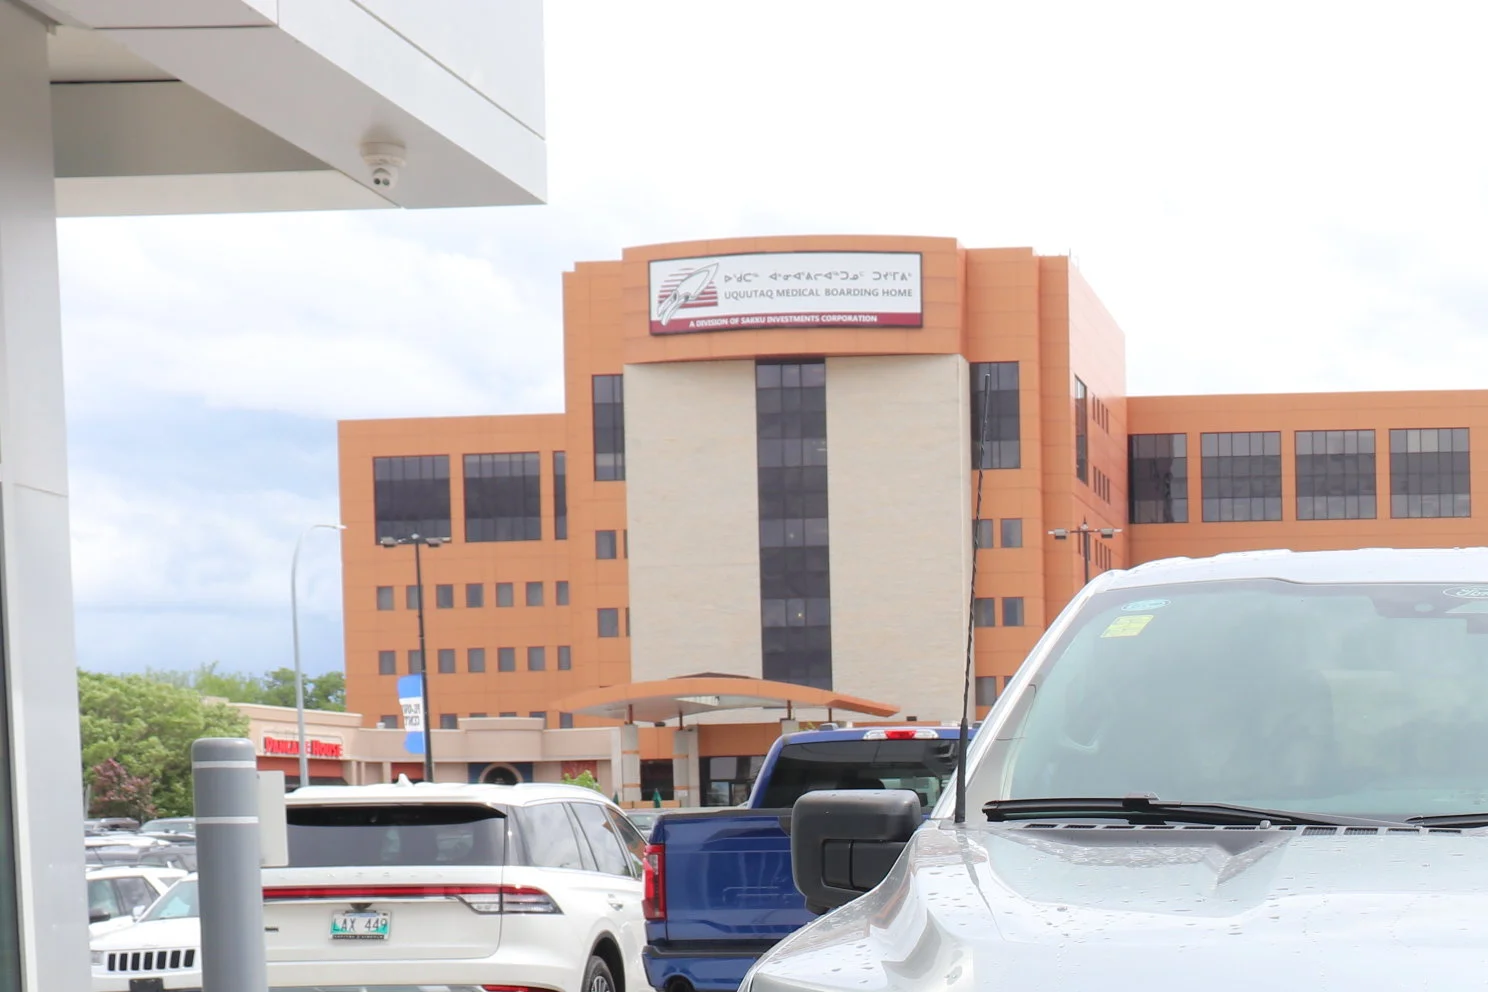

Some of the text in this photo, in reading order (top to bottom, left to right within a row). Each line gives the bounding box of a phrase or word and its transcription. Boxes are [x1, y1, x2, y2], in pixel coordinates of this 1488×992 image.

[724, 287, 913, 300] UQUUTAQ MEDICAL BOARDING HOME
[696, 318, 728, 327] DIVISION
[729, 317, 739, 325] OF
[767, 315, 820, 323] INVESTMENTS
[821, 315, 877, 323] CORPORATION
[265, 737, 311, 754] PANCAE
[333, 918, 388, 931] LAX 449
